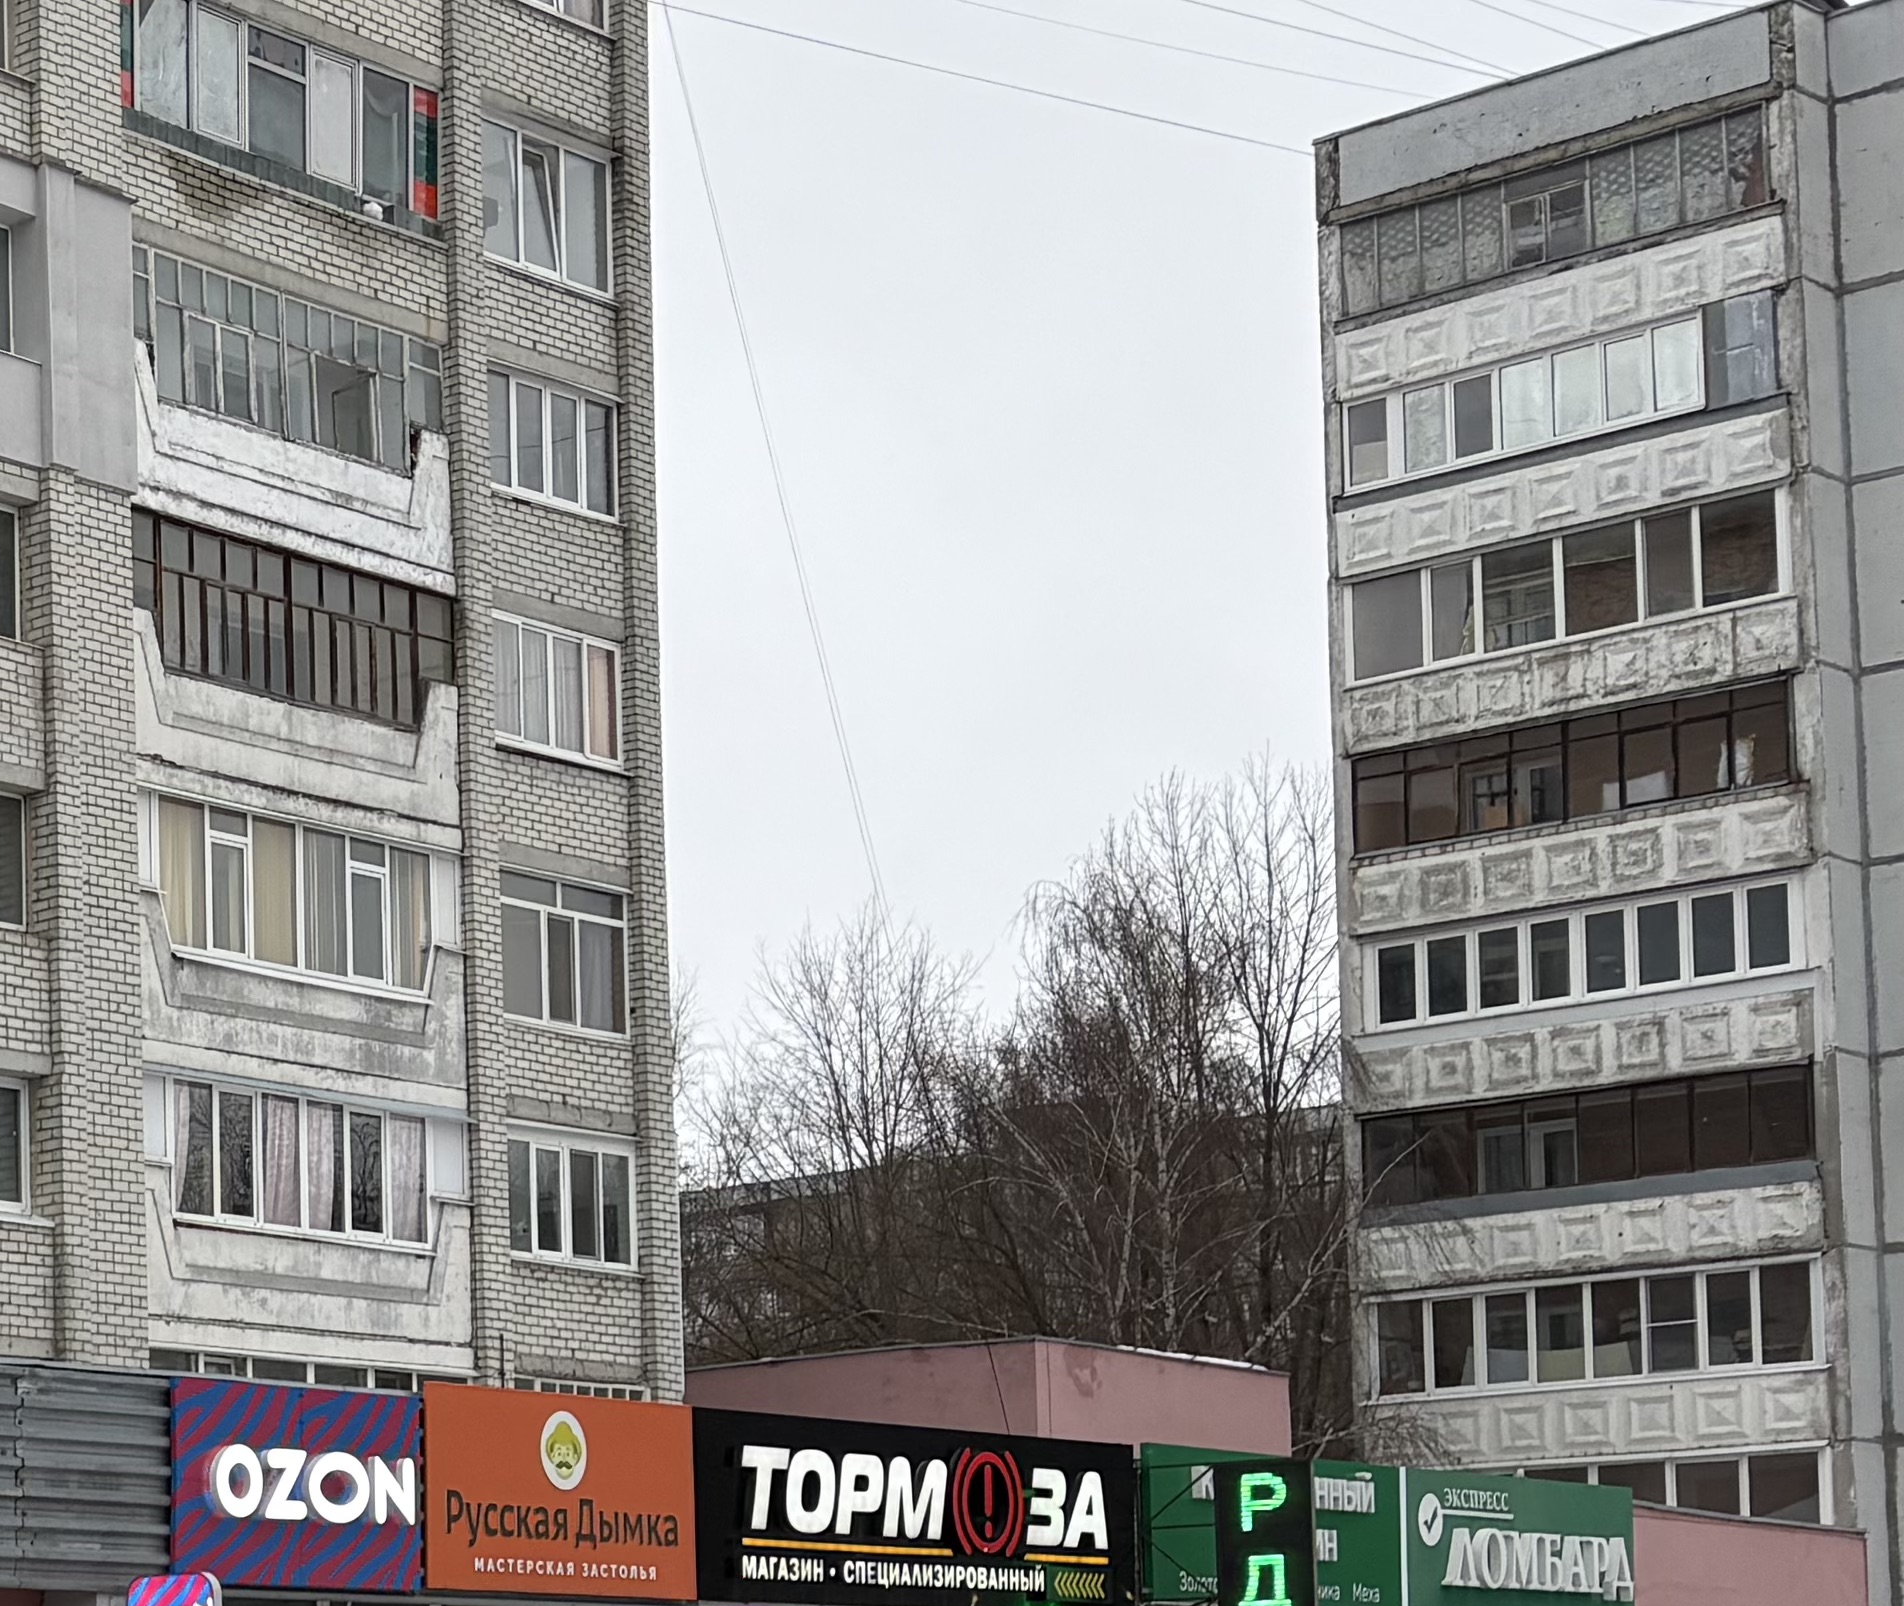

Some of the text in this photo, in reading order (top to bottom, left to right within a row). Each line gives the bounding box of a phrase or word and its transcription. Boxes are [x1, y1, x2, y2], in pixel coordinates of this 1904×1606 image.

[212, 1443, 417, 1526] OZON
[1442, 1487, 1510, 1513] ЭКСПРЕСС
[445, 1489, 679, 1551] Русская Дымка
[473, 1557, 658, 1582] МАСТЕРСКАЯ ЗАСТОЛЬЯ
[742, 1555, 1046, 1593] МАГАЗИН СПЕЦИАЛИЗИРОВАННЫЙ
[1441, 1526, 1634, 1602] ЛОМБАРД
[1352, 1583, 1381, 1603] Меха
